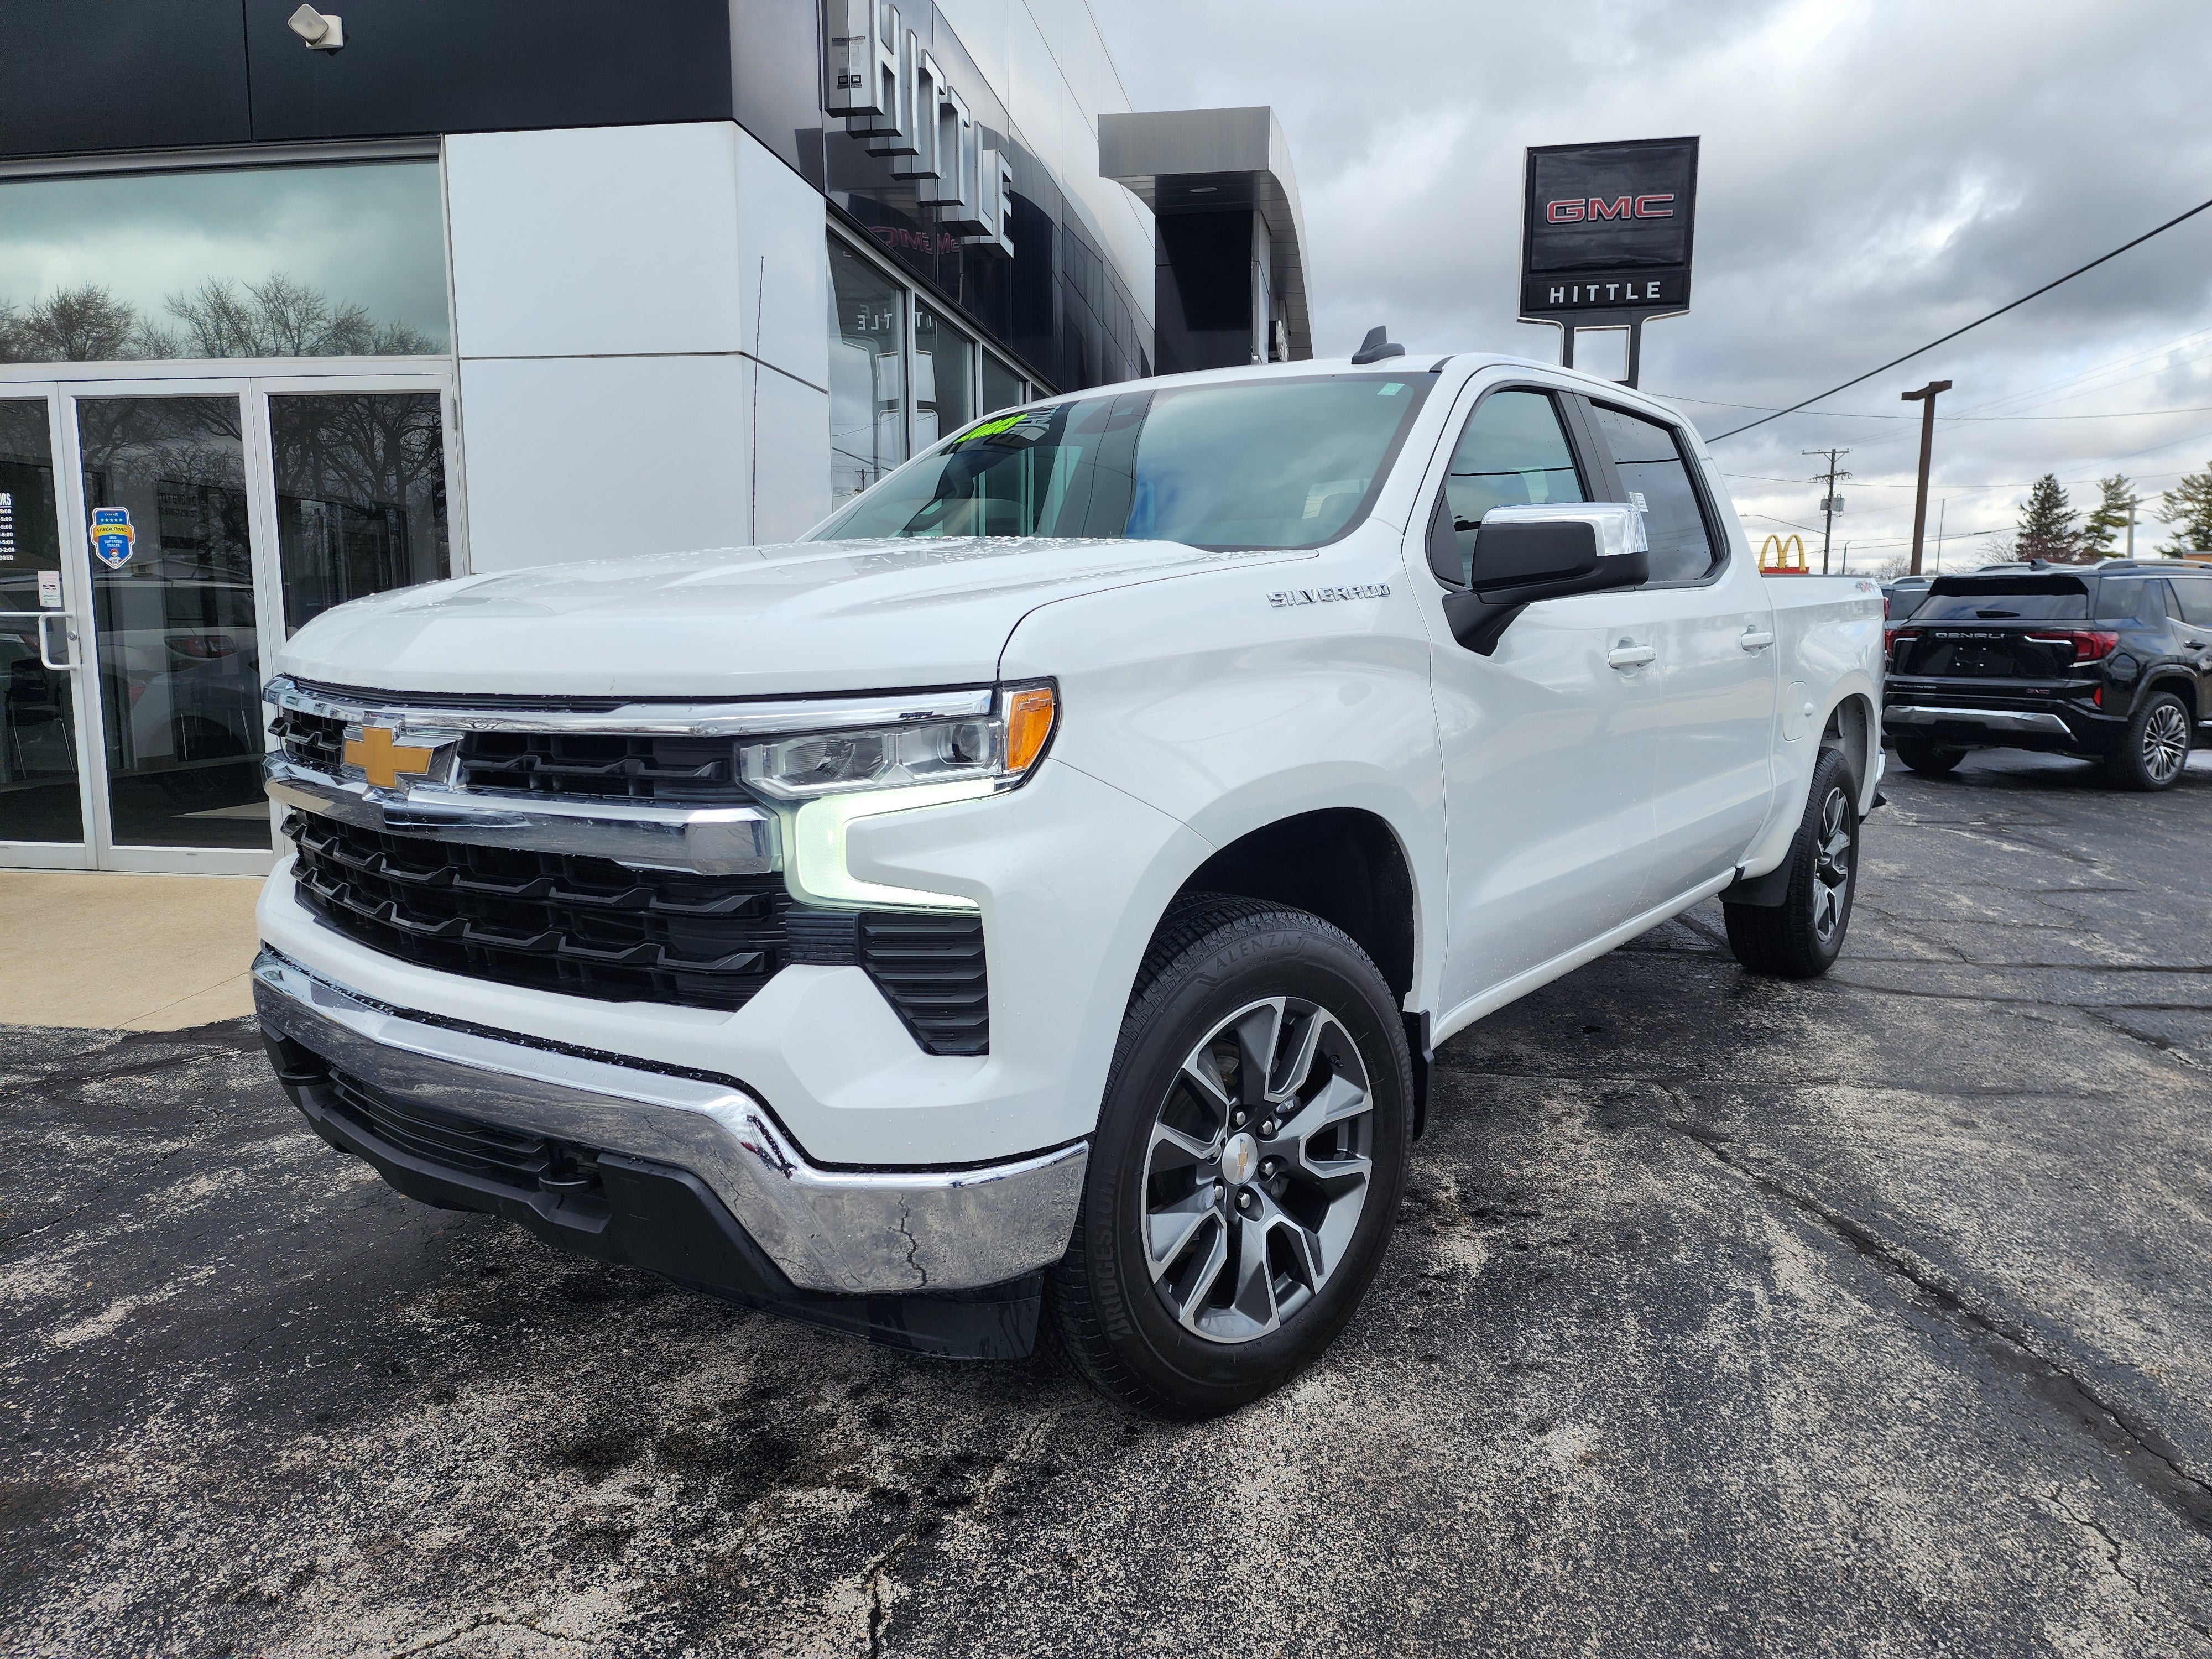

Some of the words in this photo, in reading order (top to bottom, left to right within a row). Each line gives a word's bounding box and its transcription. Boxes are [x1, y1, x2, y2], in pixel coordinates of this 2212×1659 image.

[868, 0, 1014, 258] HITTLE
[1547, 194, 1674, 223] GMC
[1550, 281, 1661, 304] HITTLE
[1267, 583, 1391, 607] SILVERADO
[1215, 933, 1293, 973] ALENZA
